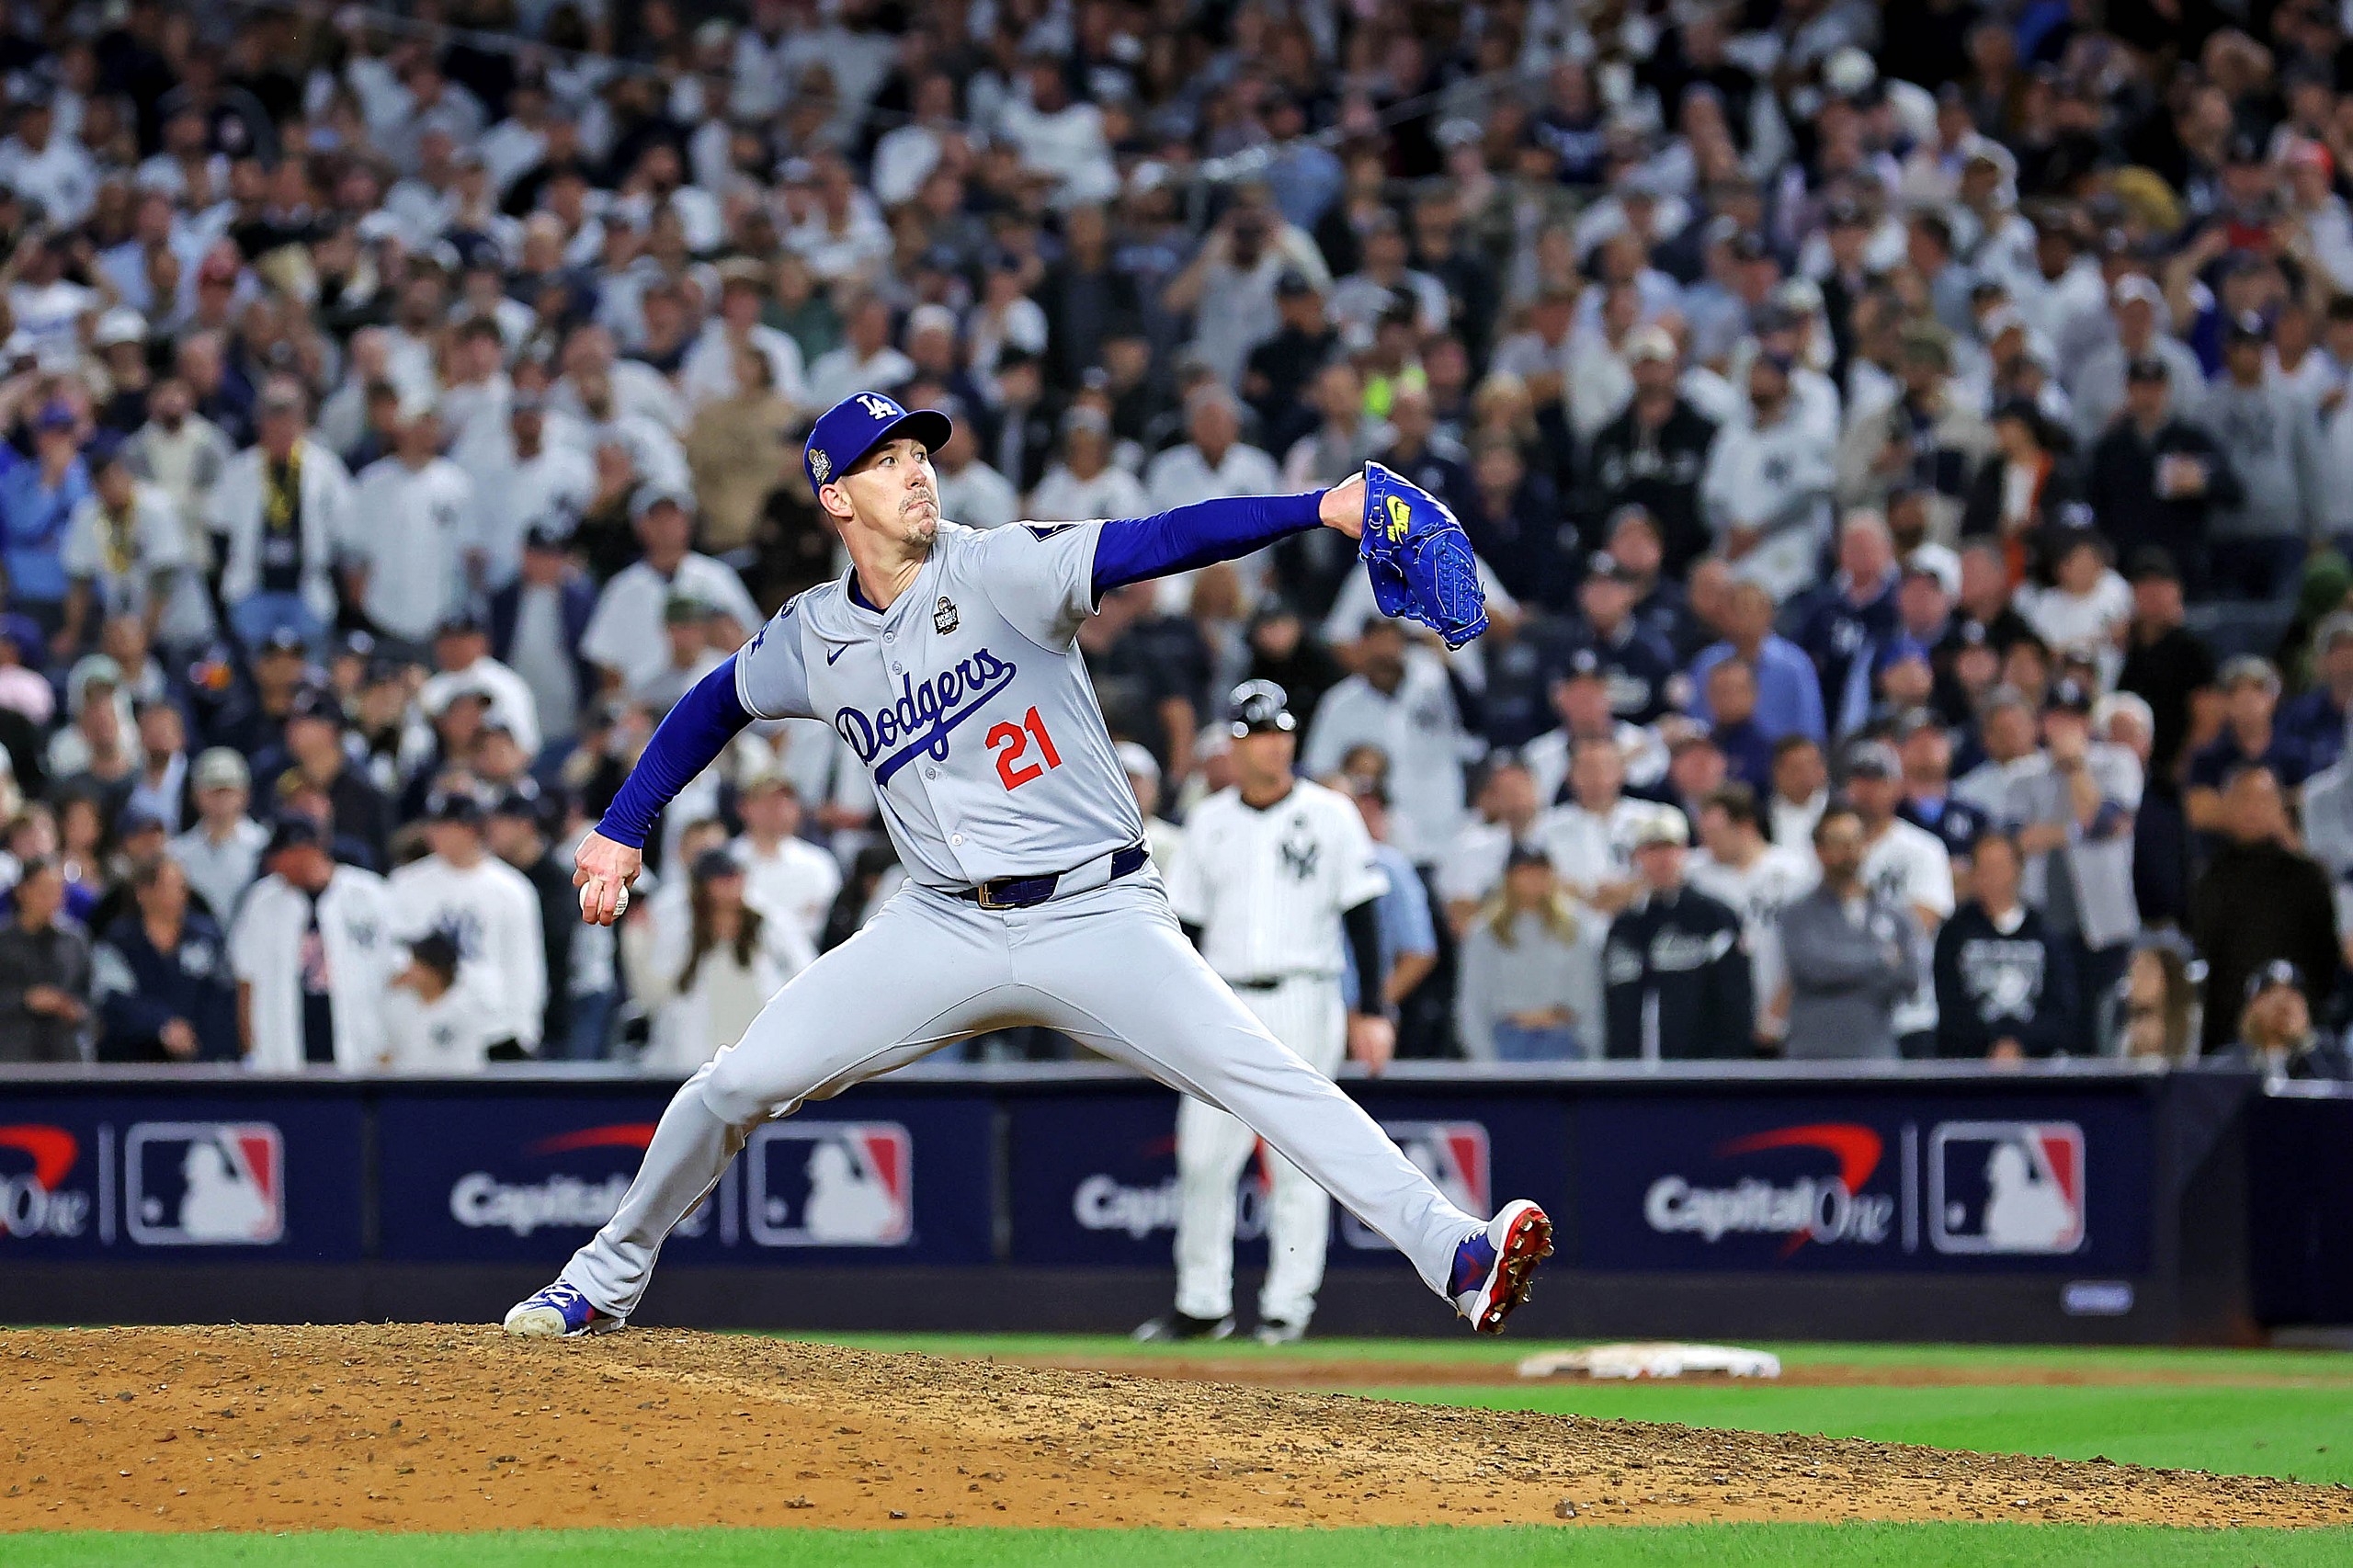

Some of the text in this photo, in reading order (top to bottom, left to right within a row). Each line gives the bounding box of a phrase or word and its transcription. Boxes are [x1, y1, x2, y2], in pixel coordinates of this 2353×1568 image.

[856, 394, 898, 420] LA
[1395, 502, 1411, 535] NIKE
[835, 647, 1017, 765] Dodgers
[984, 705, 1063, 792] 21
[1643, 1174, 1894, 1244] Capital One
